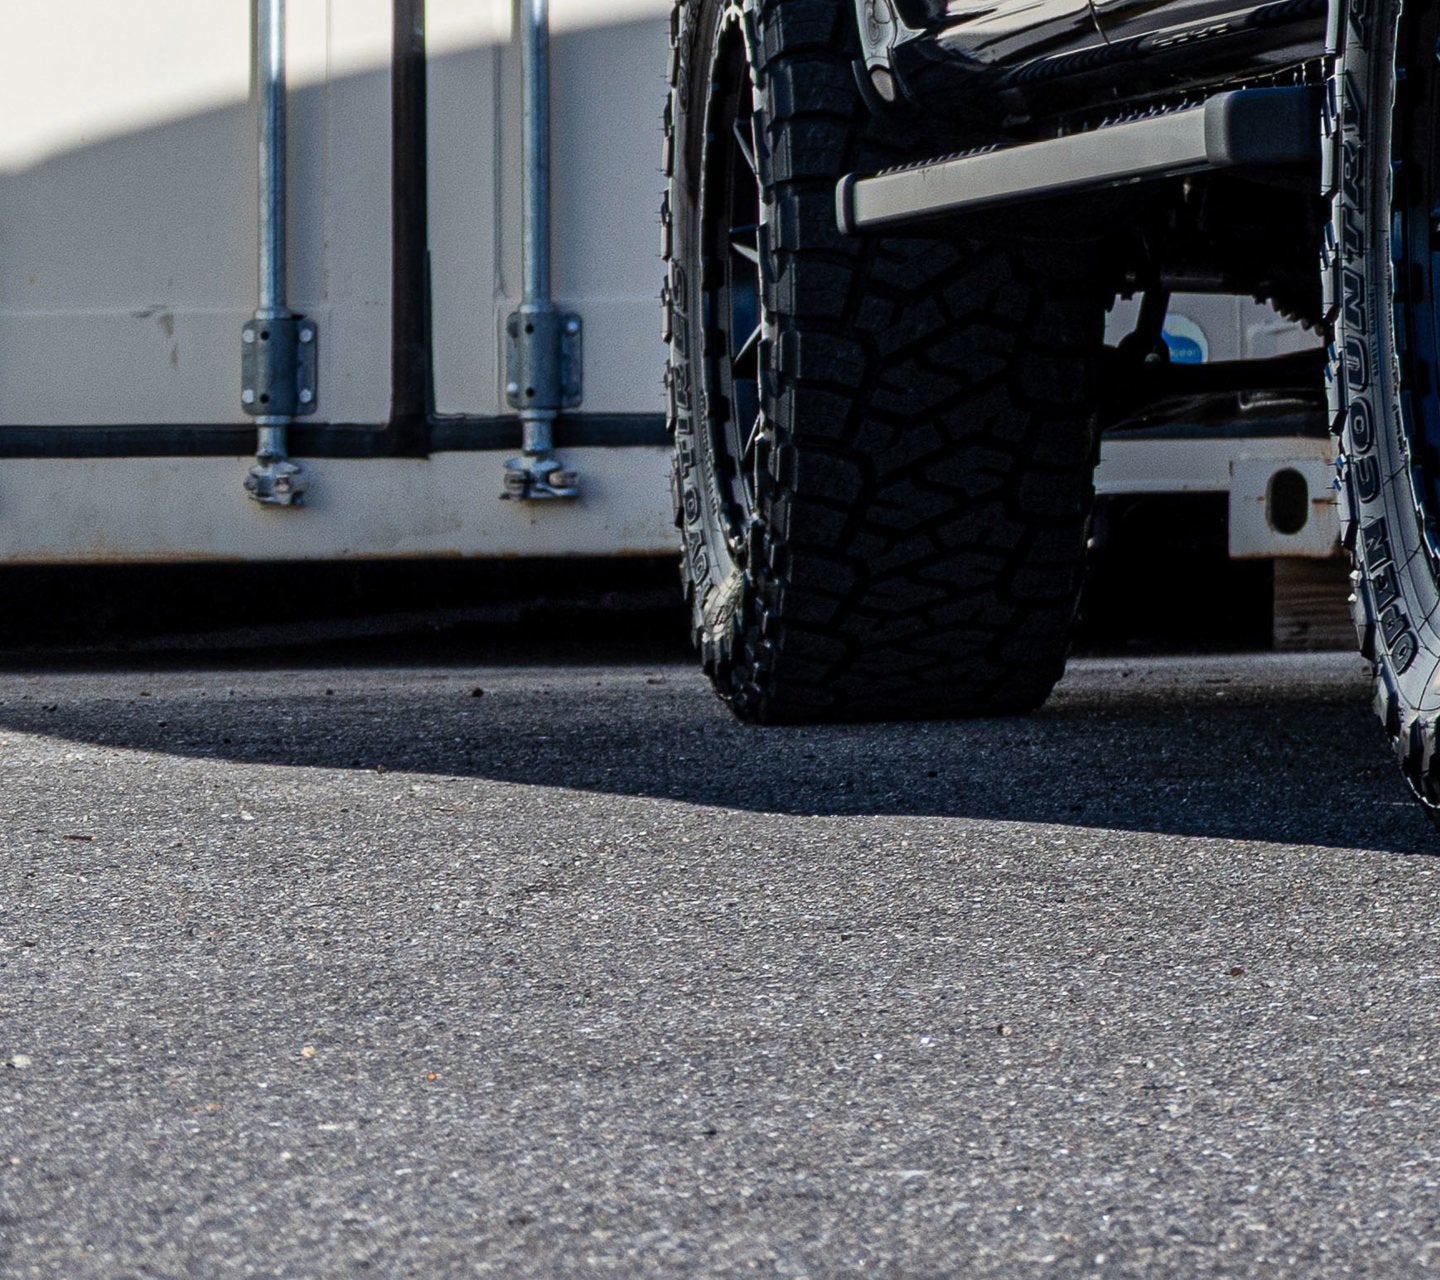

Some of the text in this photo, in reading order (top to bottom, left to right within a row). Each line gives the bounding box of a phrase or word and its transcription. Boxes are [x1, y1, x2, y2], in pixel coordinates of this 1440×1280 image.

[670, 257, 693, 480] TIRES
[1340, 69, 1380, 504] COUNTRY
[1361, 516, 1417, 675] OPEN
